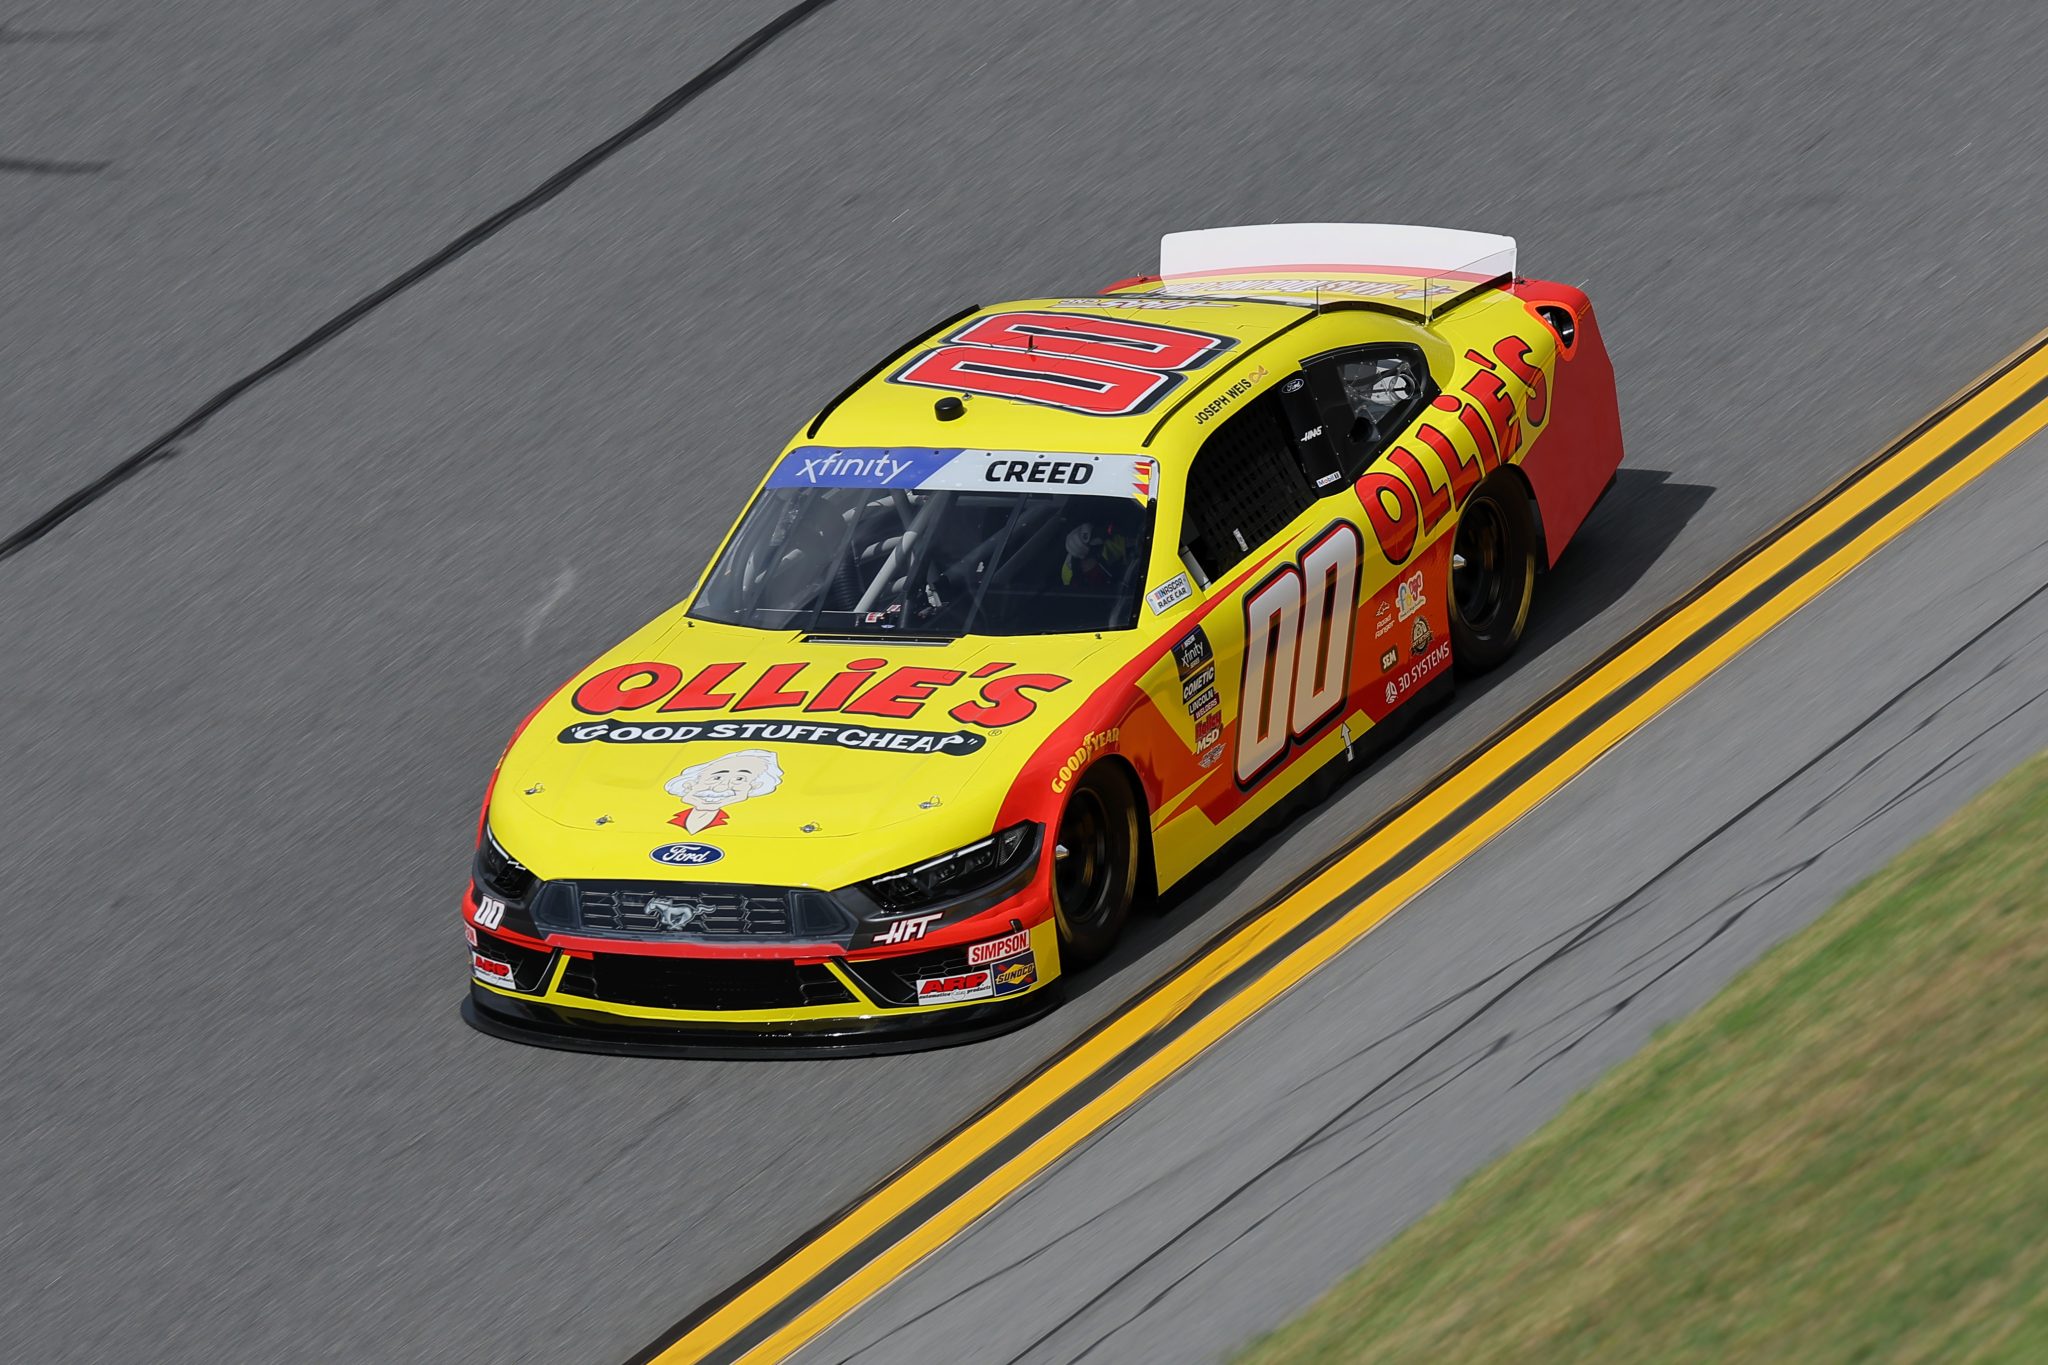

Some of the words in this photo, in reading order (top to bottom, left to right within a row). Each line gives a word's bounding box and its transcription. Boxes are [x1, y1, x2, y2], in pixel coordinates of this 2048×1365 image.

[1194, 396, 1231, 425] JOSEPH
[1226, 378, 1252, 401] WEIS
[797, 453, 914, 484] xfinity
[985, 460, 1094, 486] CREED
[1318, 474, 1336, 487] Mobil
[1158, 595, 1174, 609] RACE
[1175, 587, 1187, 599] CAR
[1160, 577, 1184, 597] NASCAR
[1181, 641, 1204, 668] xfinity
[1235, 520, 1362, 790] 00
[1382, 649, 1397, 670] SEM
[1398, 672, 1411, 693] 3D
[1411, 641, 1450, 683] SYSTEMS
[1184, 666, 1214, 699] COMETIC
[1189, 688, 1214, 714] LINCOLN
[1195, 699, 1218, 719] WELDERS
[707, 722, 846, 741] STUFF
[1196, 728, 1220, 754] MSD
[662, 845, 710, 863] Ford
[473, 895, 505, 930] 00
[873, 912, 943, 944] HFT
[971, 933, 1028, 963] SIMPSON
[475, 955, 510, 977] ARP
[995, 962, 1035, 985] SUNOCO
[919, 971, 990, 995] ARP
[967, 985, 991, 995] products
